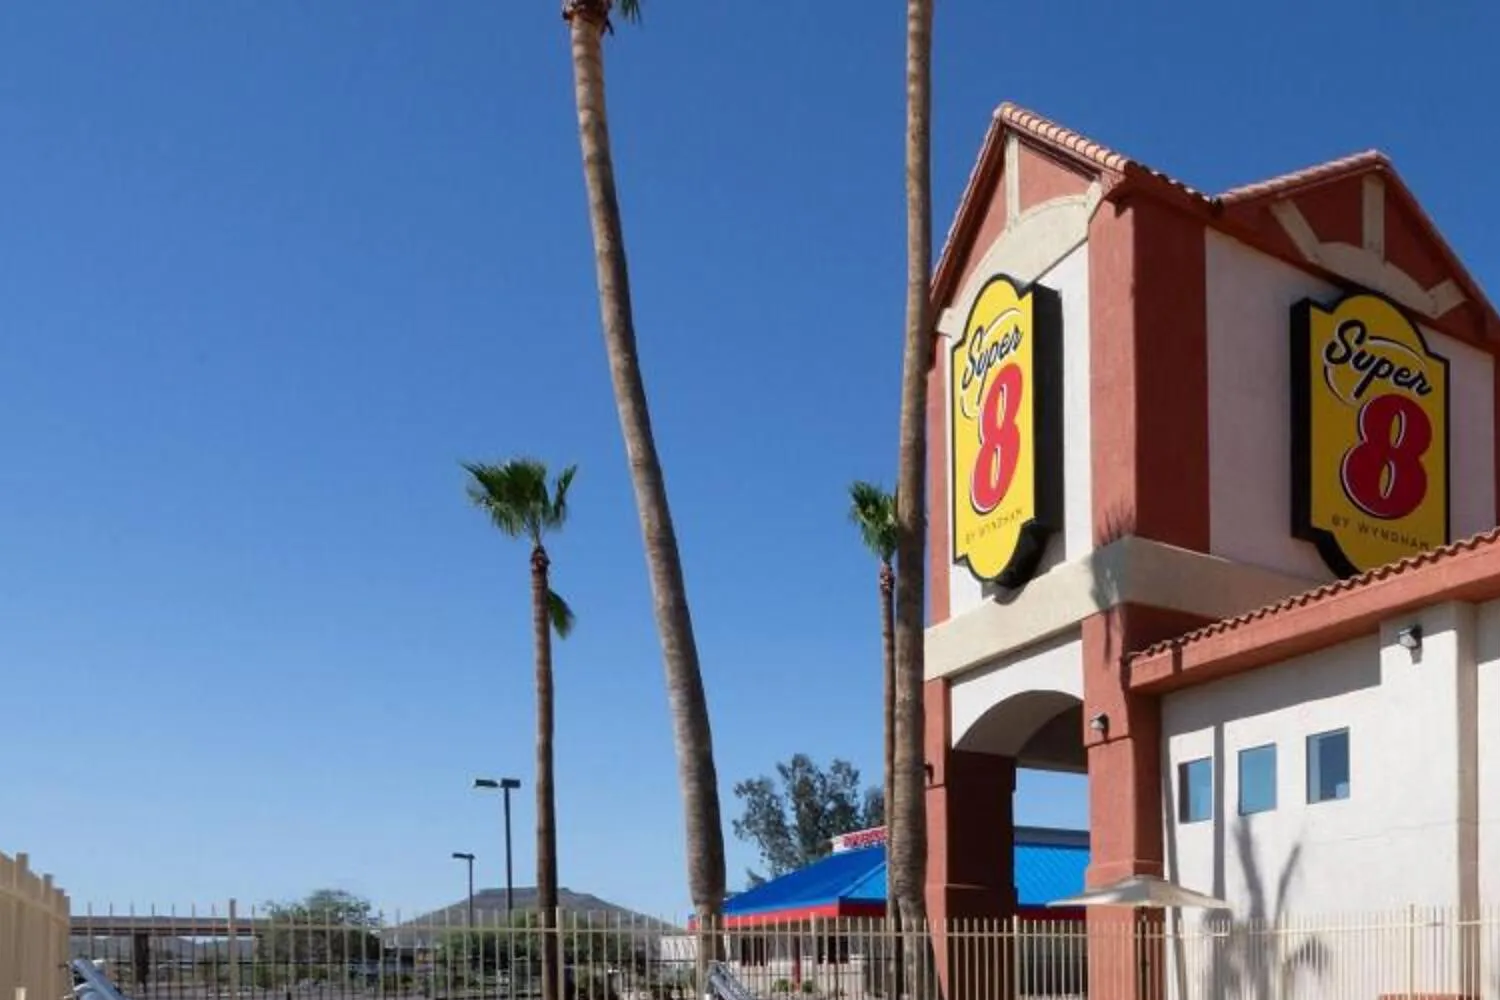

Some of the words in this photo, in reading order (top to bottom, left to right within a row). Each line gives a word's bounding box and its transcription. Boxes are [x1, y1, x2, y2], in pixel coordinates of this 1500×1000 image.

[961, 325, 1023, 405] Super
[1324, 319, 1432, 399] Super
[970, 363, 1023, 515] 8
[1341, 394, 1432, 520] 8
[1332, 514, 1351, 529] BY
[1358, 522, 1429, 551] WYNDHAM
